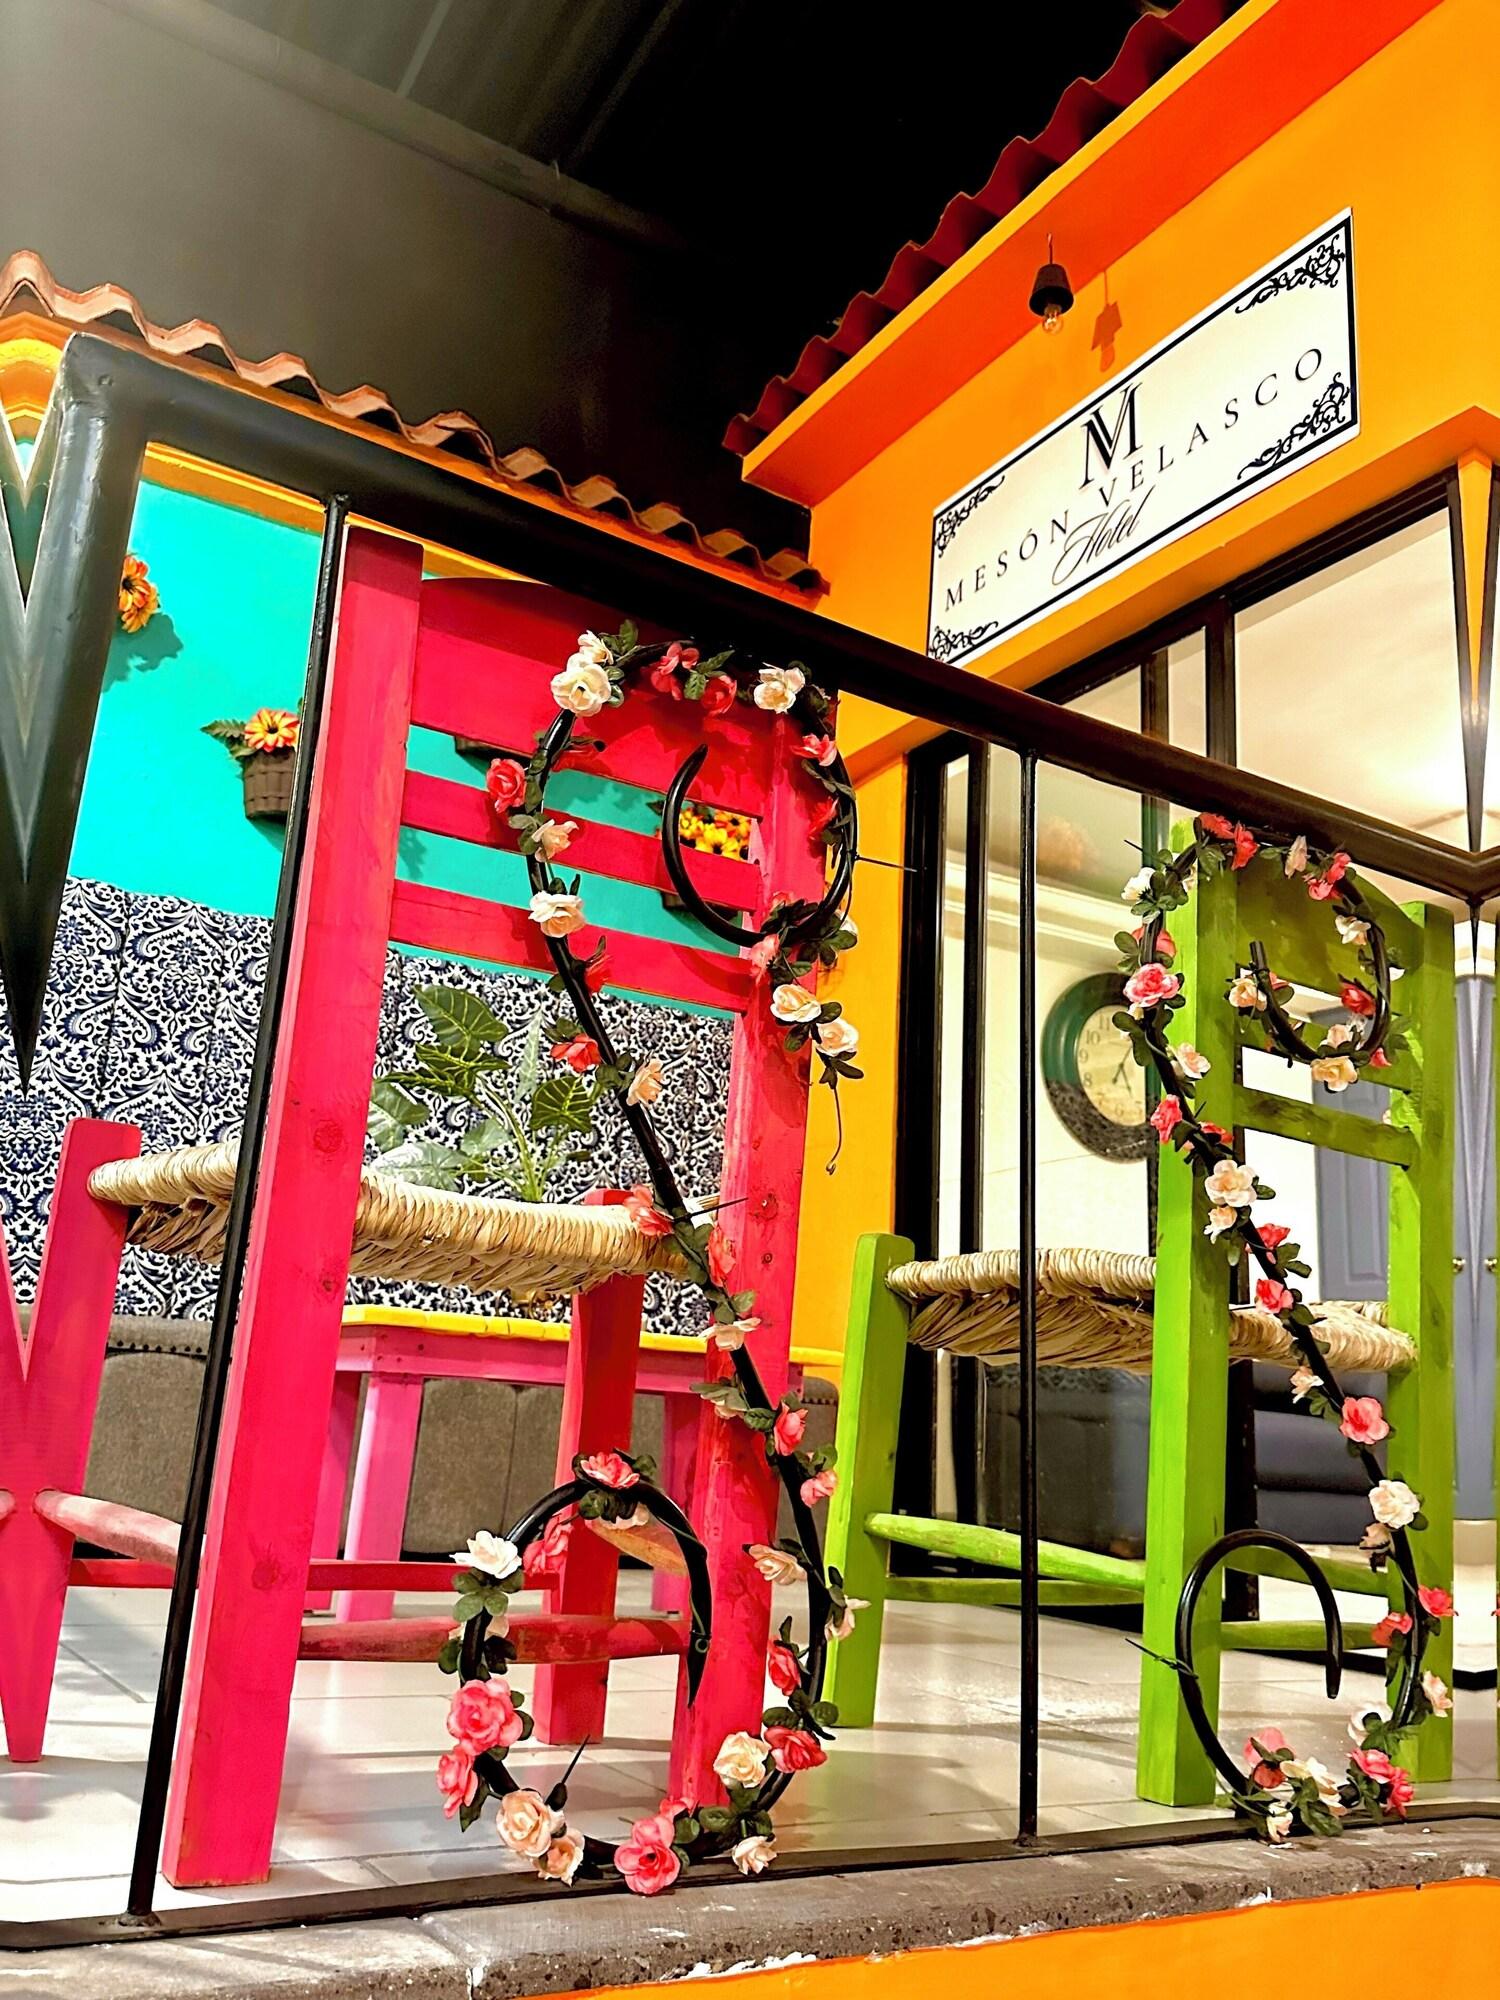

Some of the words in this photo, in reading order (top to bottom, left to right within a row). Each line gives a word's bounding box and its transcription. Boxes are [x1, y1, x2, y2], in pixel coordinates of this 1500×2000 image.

[945, 508, 1071, 612] MESÓN
[1098, 347, 1323, 508] VELASCO
[1051, 485, 1156, 586] Hotel
[1099, 1014, 1110, 1031] 11
[1085, 1030, 1100, 1045] 10
[1079, 1048, 1089, 1063] 9
[1083, 1072, 1093, 1088] 8
[1115, 1102, 1125, 1117] 6
